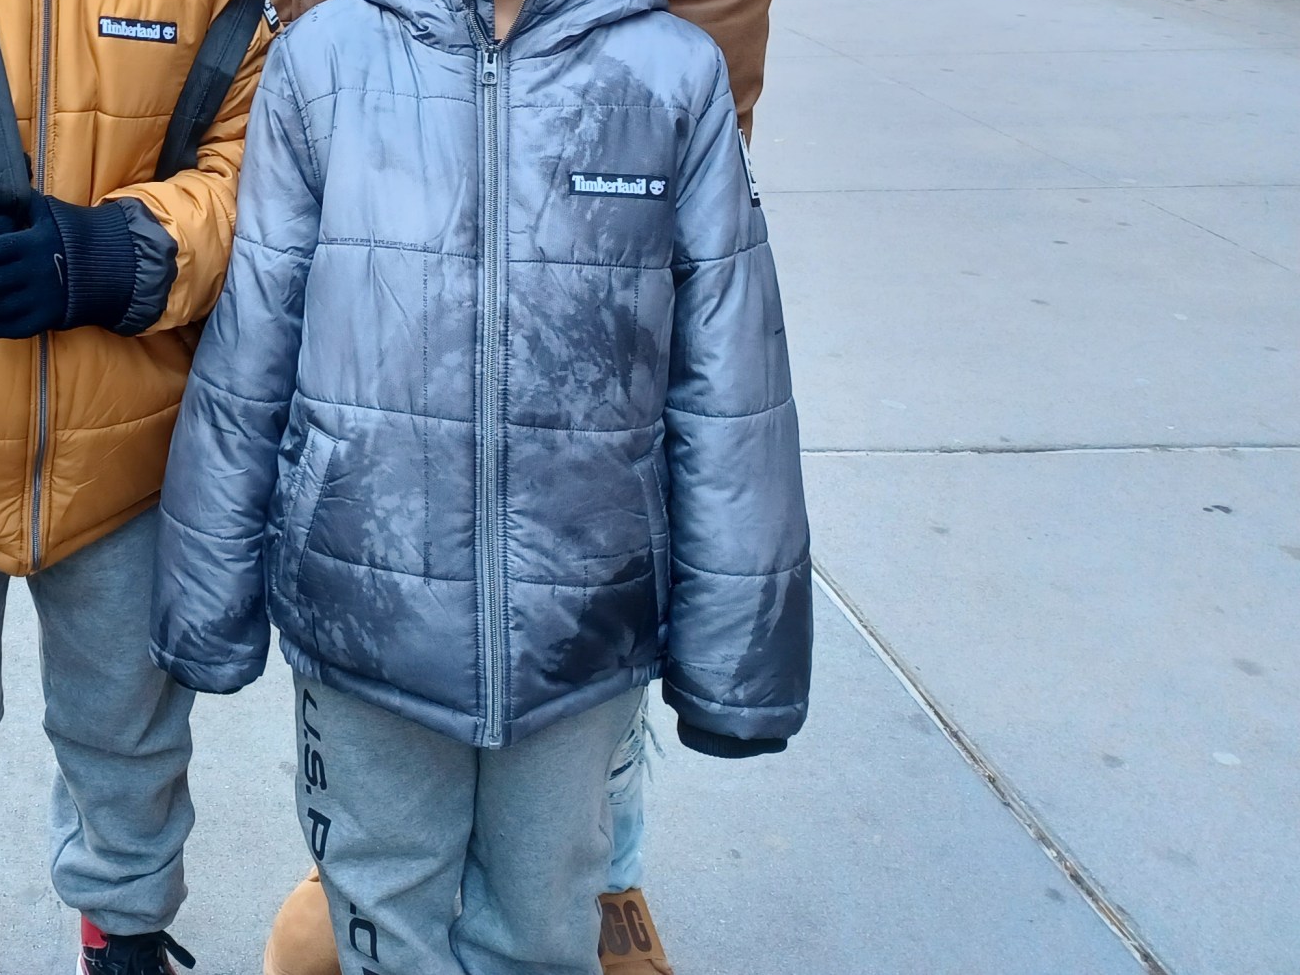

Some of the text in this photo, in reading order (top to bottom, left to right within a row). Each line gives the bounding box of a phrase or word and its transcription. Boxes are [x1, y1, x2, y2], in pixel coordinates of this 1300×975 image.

[100, 18, 161, 39] Timberland
[571, 174, 647, 195] Timberland
[302, 688, 328, 795] U.S.
[601, 899, 653, 956] GG
